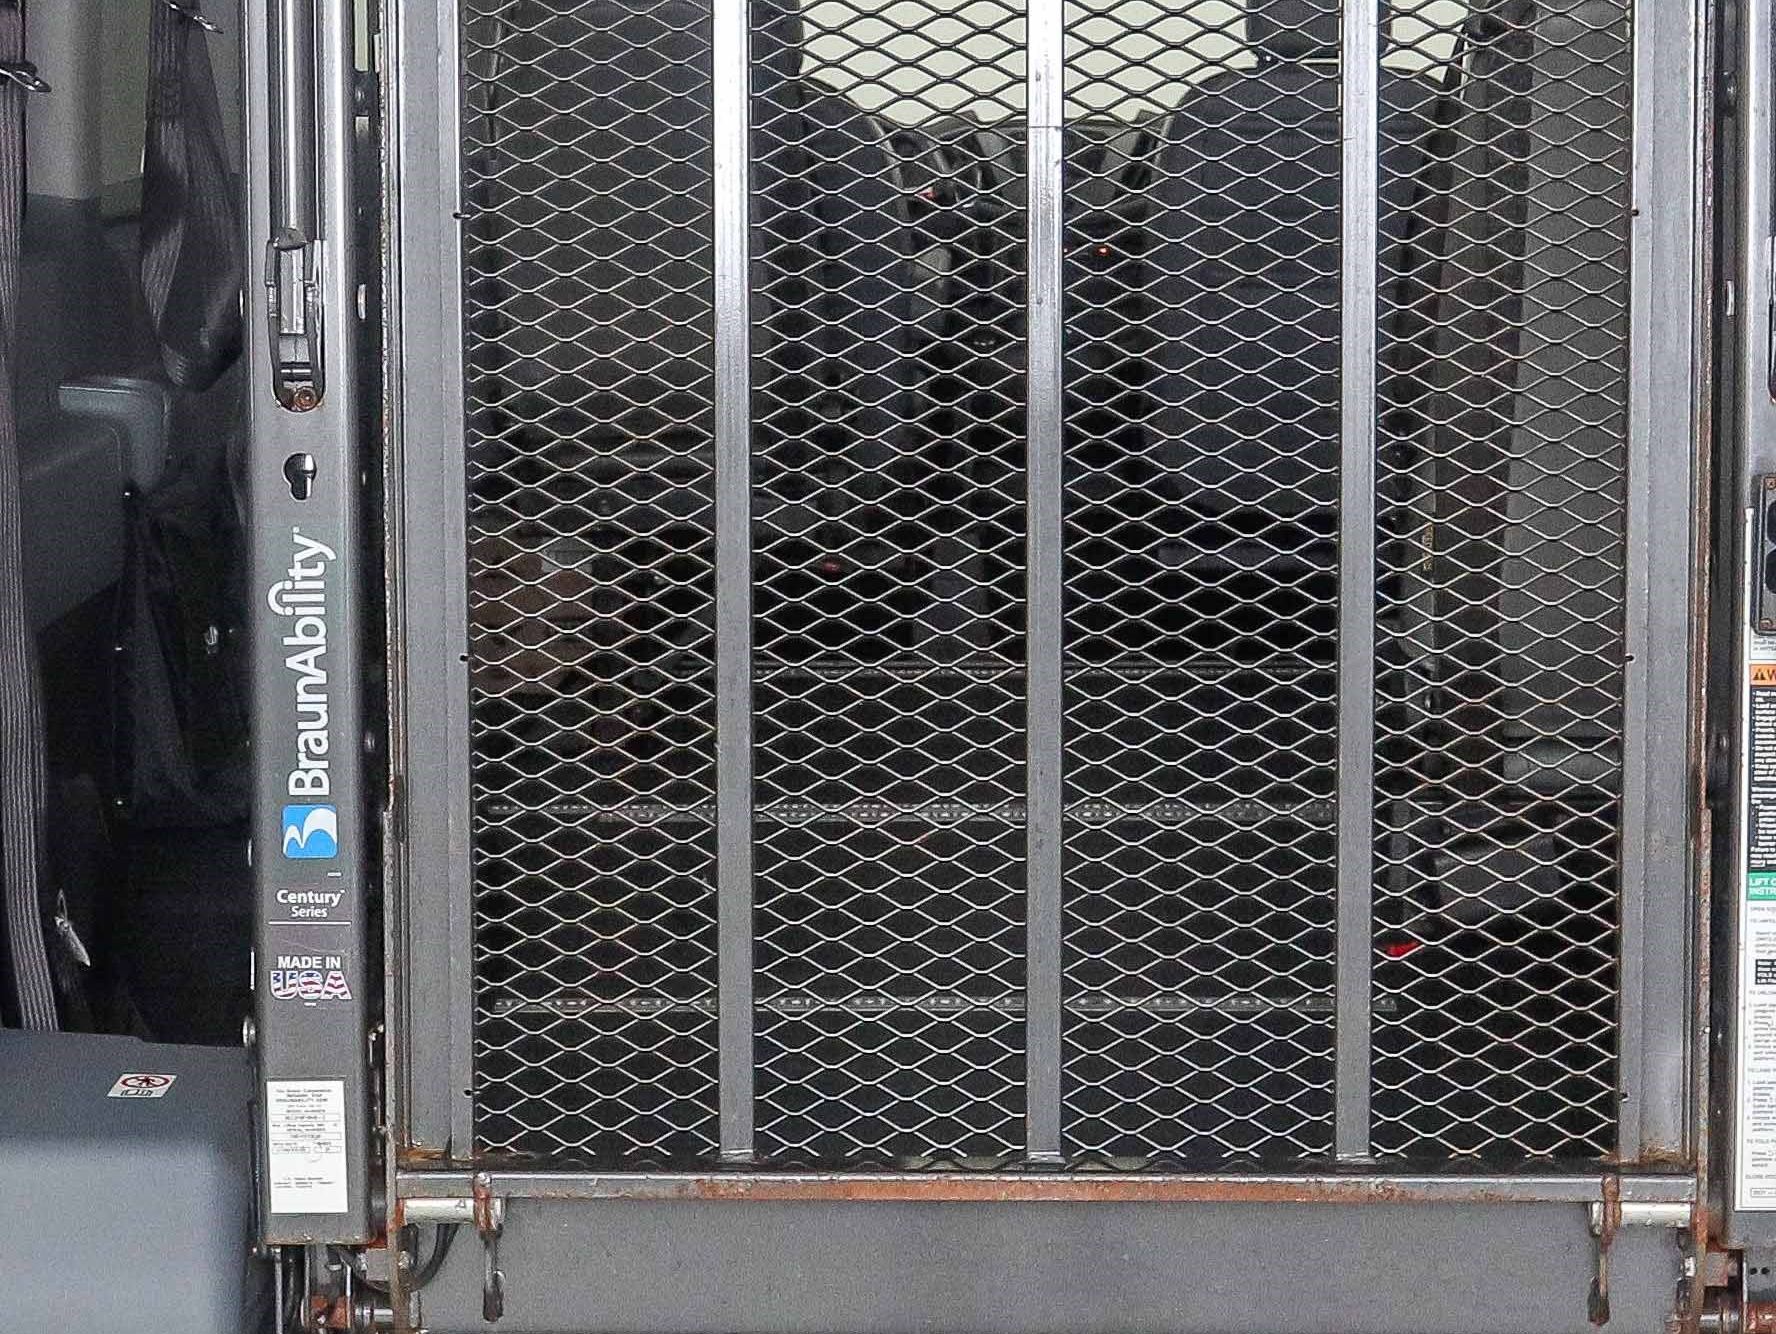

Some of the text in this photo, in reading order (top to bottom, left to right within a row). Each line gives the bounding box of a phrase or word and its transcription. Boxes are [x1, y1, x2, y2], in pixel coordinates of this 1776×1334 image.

[267, 530, 336, 796] BraunAbility
[276, 889, 342, 909] Century
[290, 905, 328, 919] Series
[277, 956, 341, 970] MADE IN
[270, 970, 352, 1000] USA
